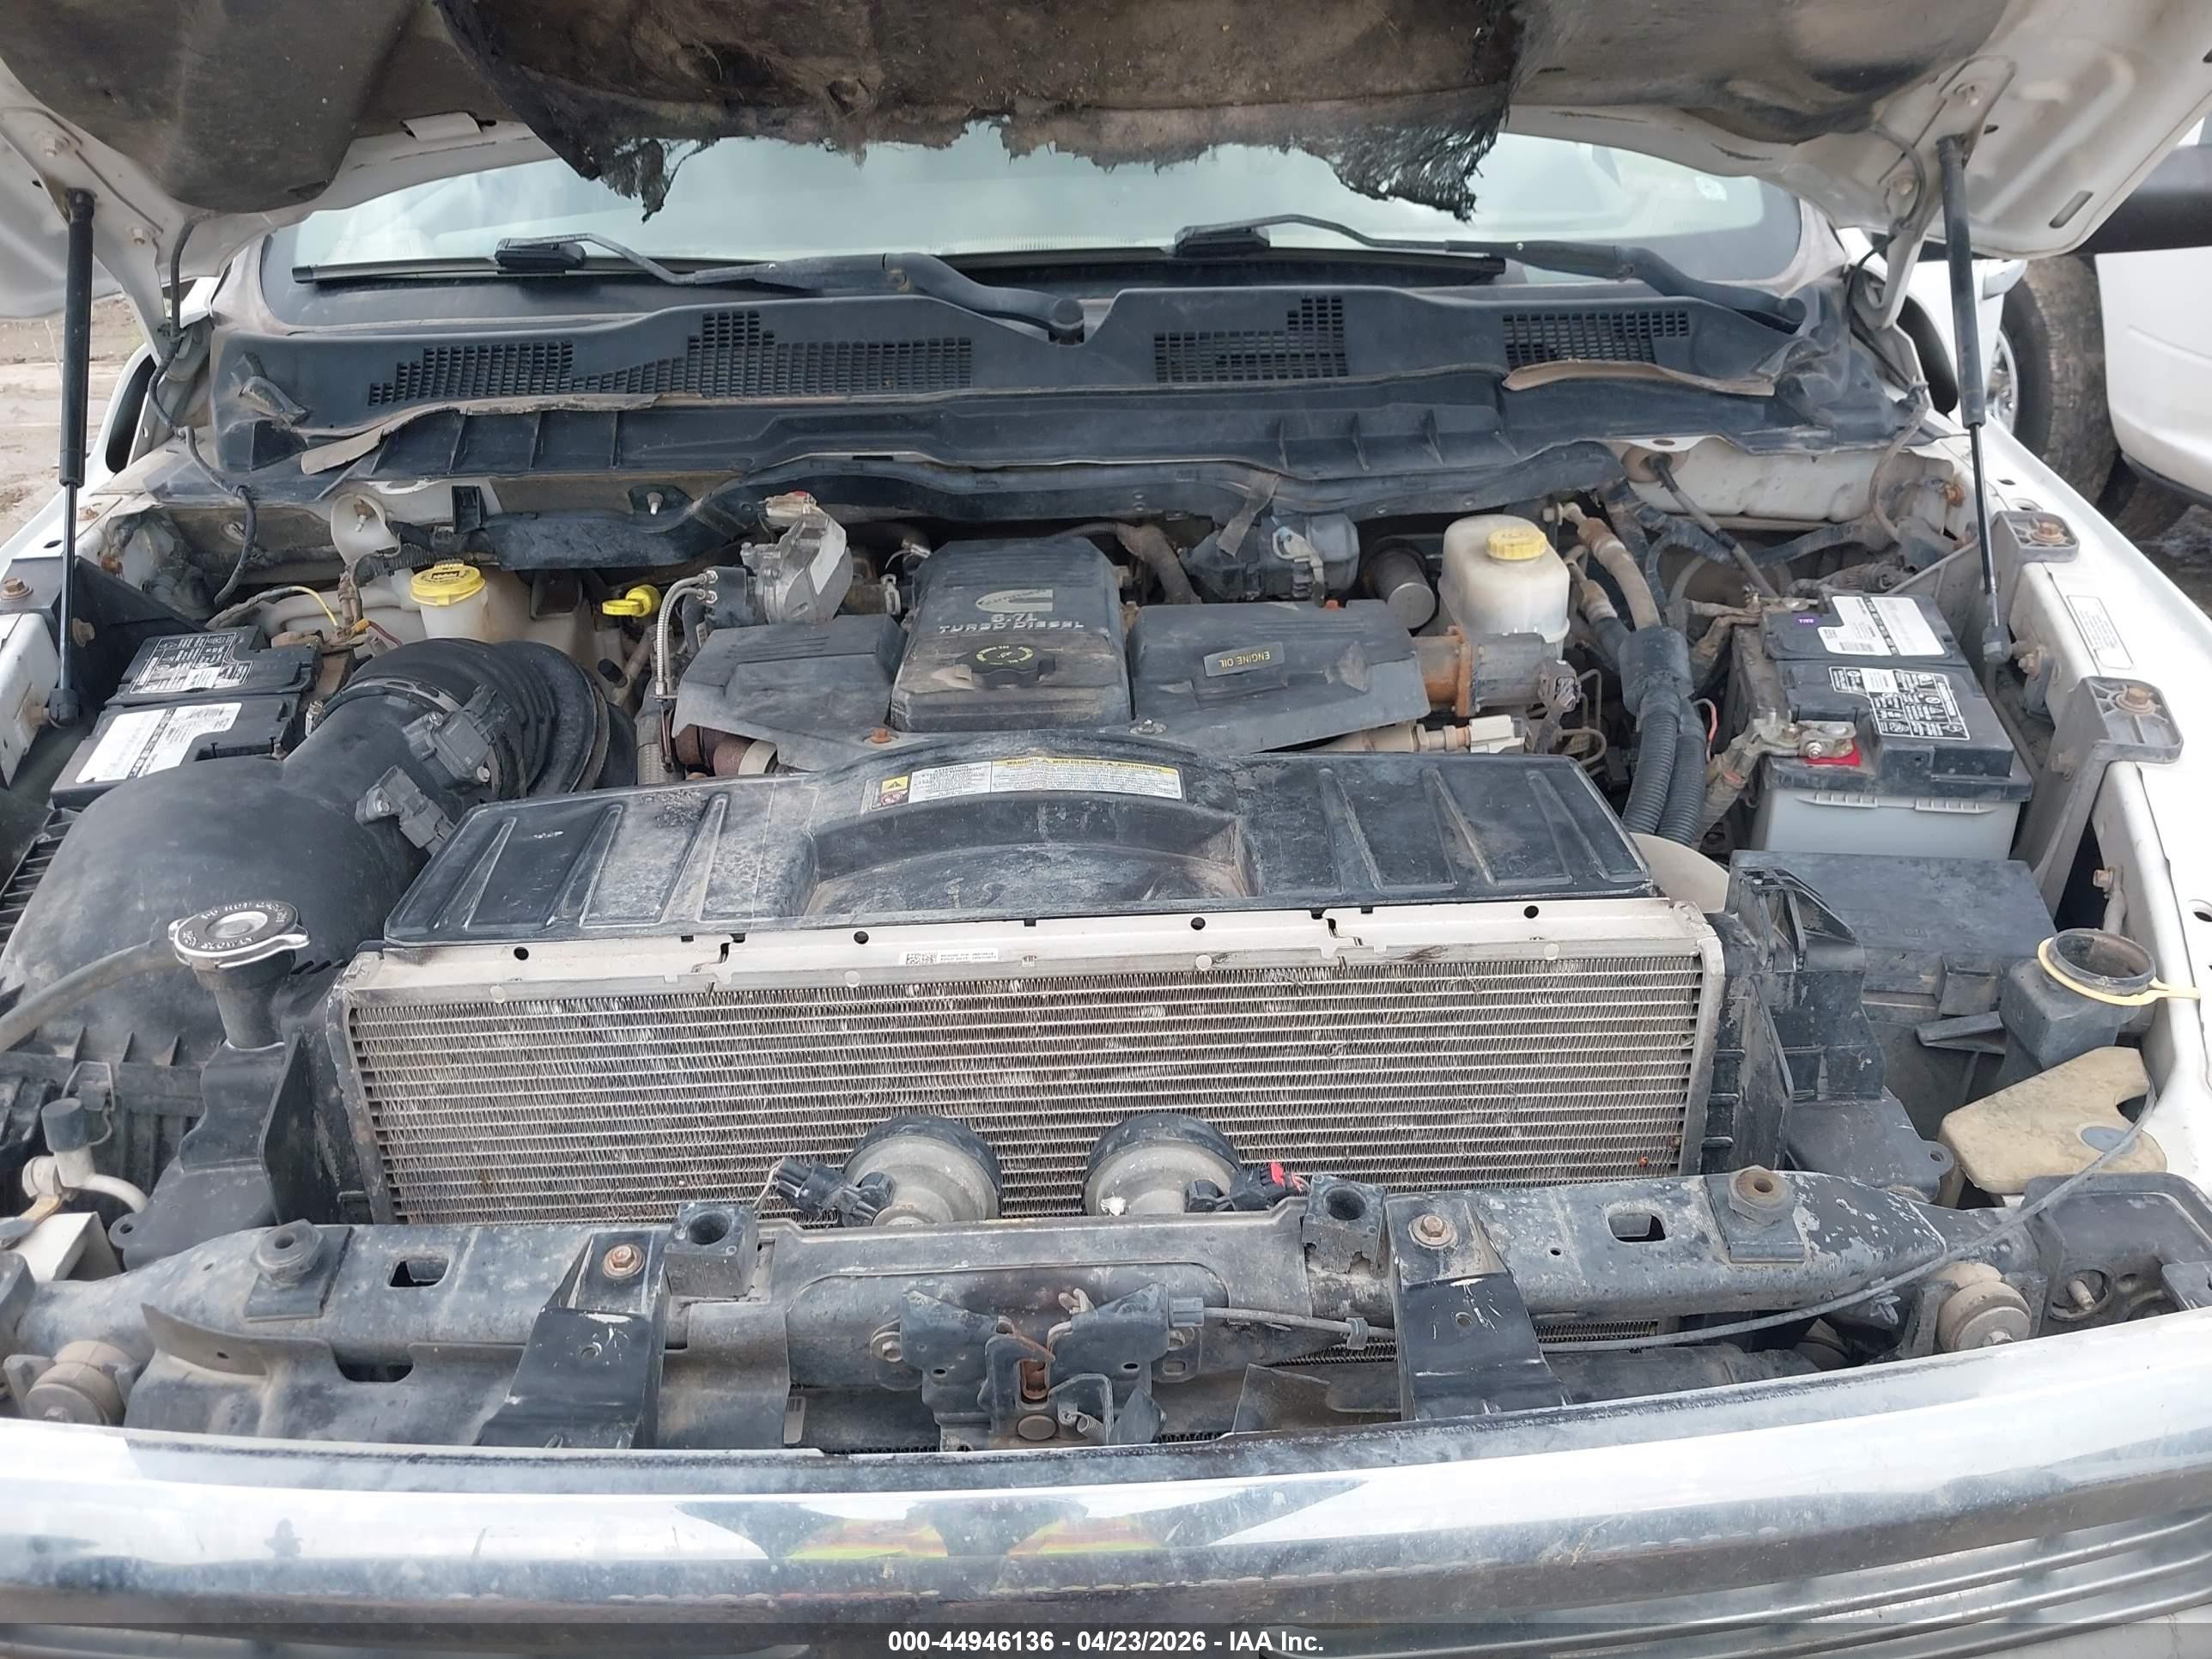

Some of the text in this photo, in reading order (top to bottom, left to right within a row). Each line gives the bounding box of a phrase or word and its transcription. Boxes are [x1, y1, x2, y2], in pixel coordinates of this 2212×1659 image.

[991, 613, 1038, 623] 6.7L
[939, 620, 1085, 634] TURBO DIESEL
[1218, 651, 1270, 668] ENGINE OIL
